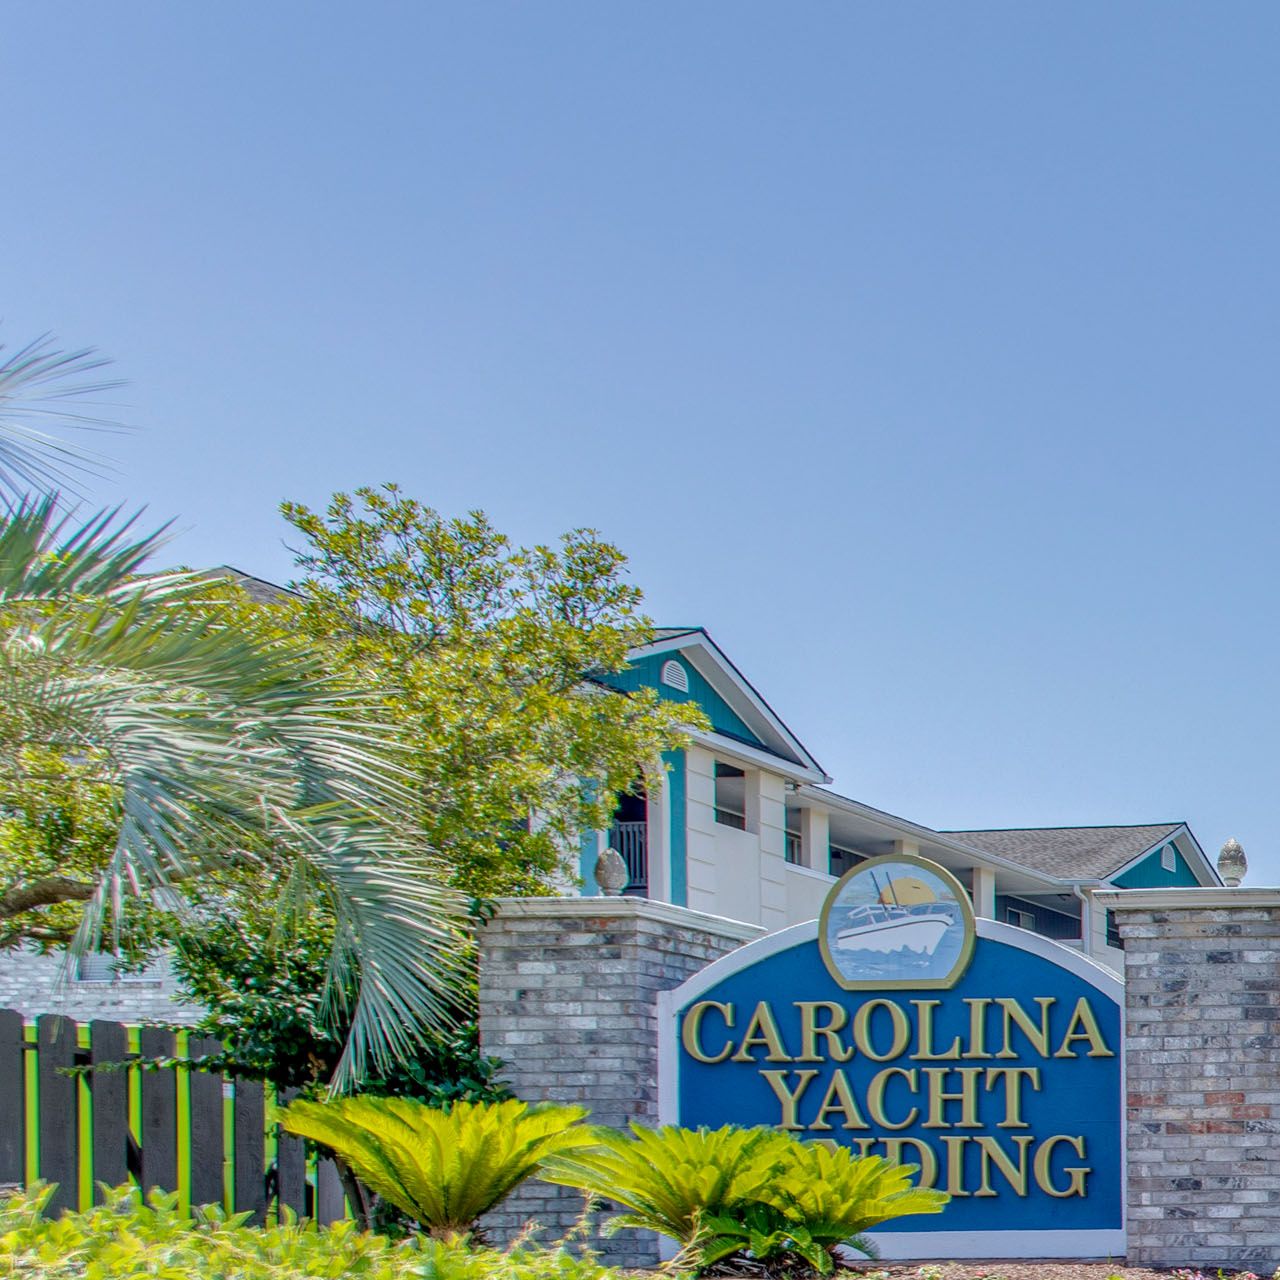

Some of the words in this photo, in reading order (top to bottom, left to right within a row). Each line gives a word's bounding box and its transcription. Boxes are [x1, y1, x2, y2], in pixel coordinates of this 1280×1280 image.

[682, 997, 1115, 1064] CAROLINA
[758, 1067, 1041, 1131] YACHT
[800, 1135, 1092, 1198] DING
